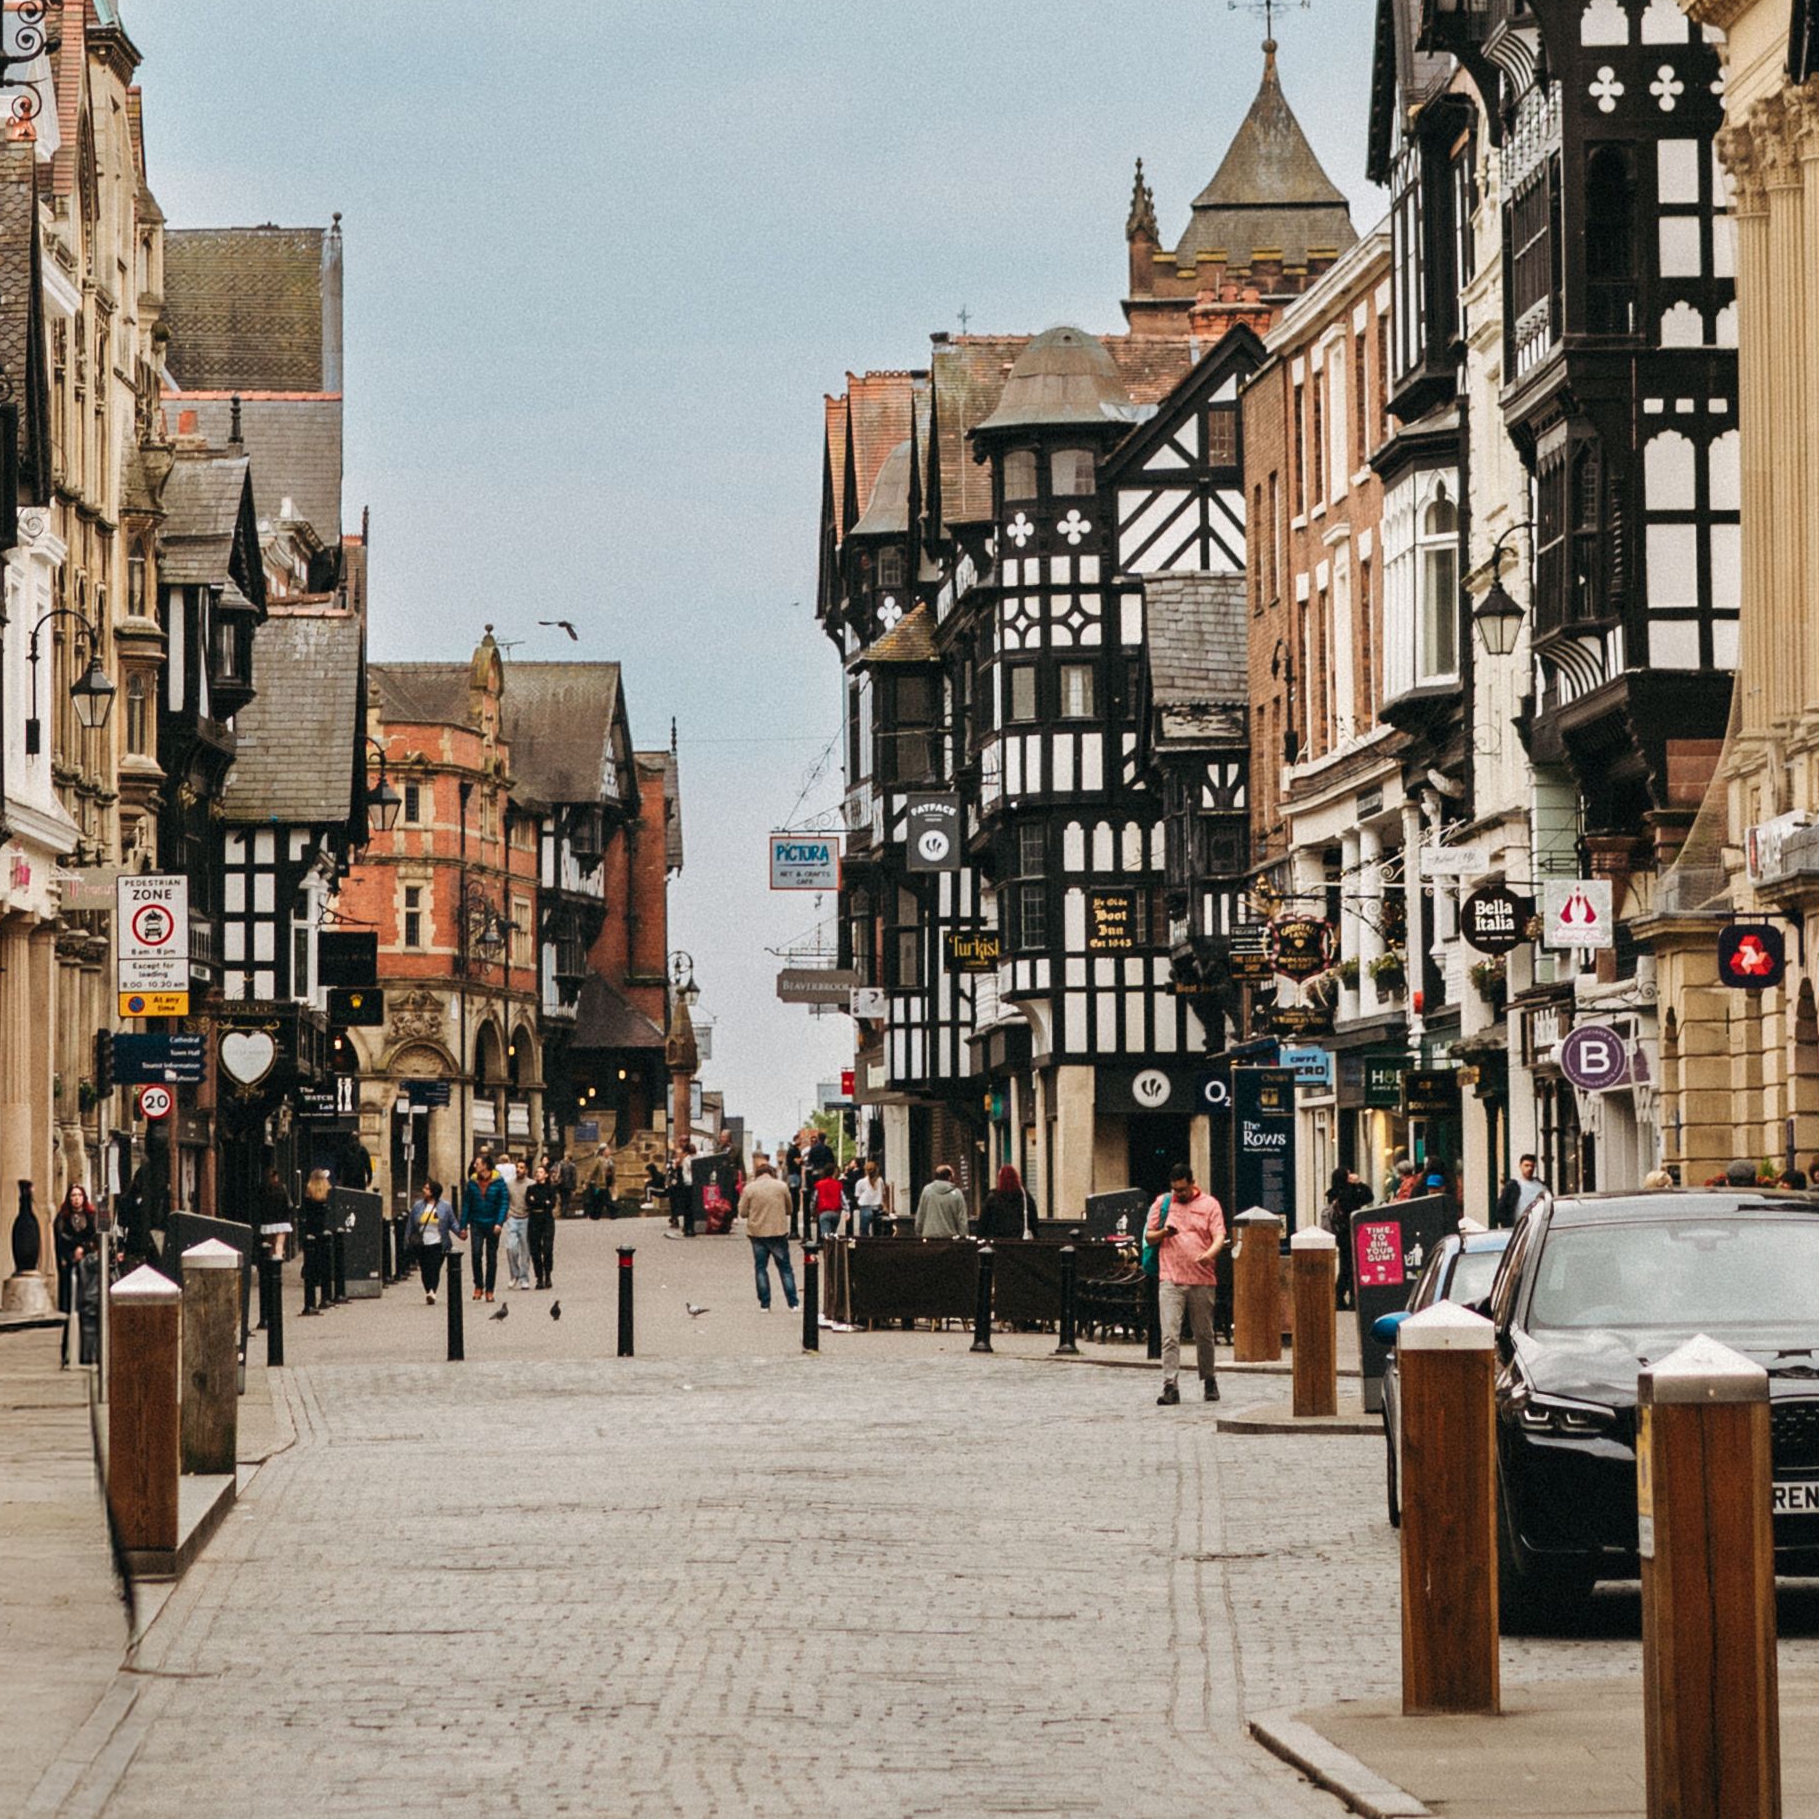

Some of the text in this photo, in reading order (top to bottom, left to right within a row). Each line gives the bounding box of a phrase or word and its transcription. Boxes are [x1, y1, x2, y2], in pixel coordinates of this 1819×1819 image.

[910, 802, 957, 817] FATFACE
[124, 879, 181, 887] PEDESTRIAN
[132, 889, 173, 901] ZONE
[1474, 899, 1513, 916] Bella
[1475, 916, 1516, 931] Italia
[132, 962, 161, 971] Except
[138, 970, 168, 979] loading
[164, 997, 180, 1005] any
[157, 1004, 176, 1012] time
[169, 1036, 200, 1044] Cathedral
[1580, 1041, 1611, 1074] B
[299, 1086, 314, 1094] The
[144, 1094, 169, 1109] 20
[1242, 1120, 1261, 1131] The
[1242, 1130, 1287, 1147] Rows
[1371, 1233, 1386, 1241] TO
[1370, 1240, 1389, 1248] BIN
[1365, 1246, 1394, 1255] YOUR
[1367, 1252, 1396, 1263] GUM?
